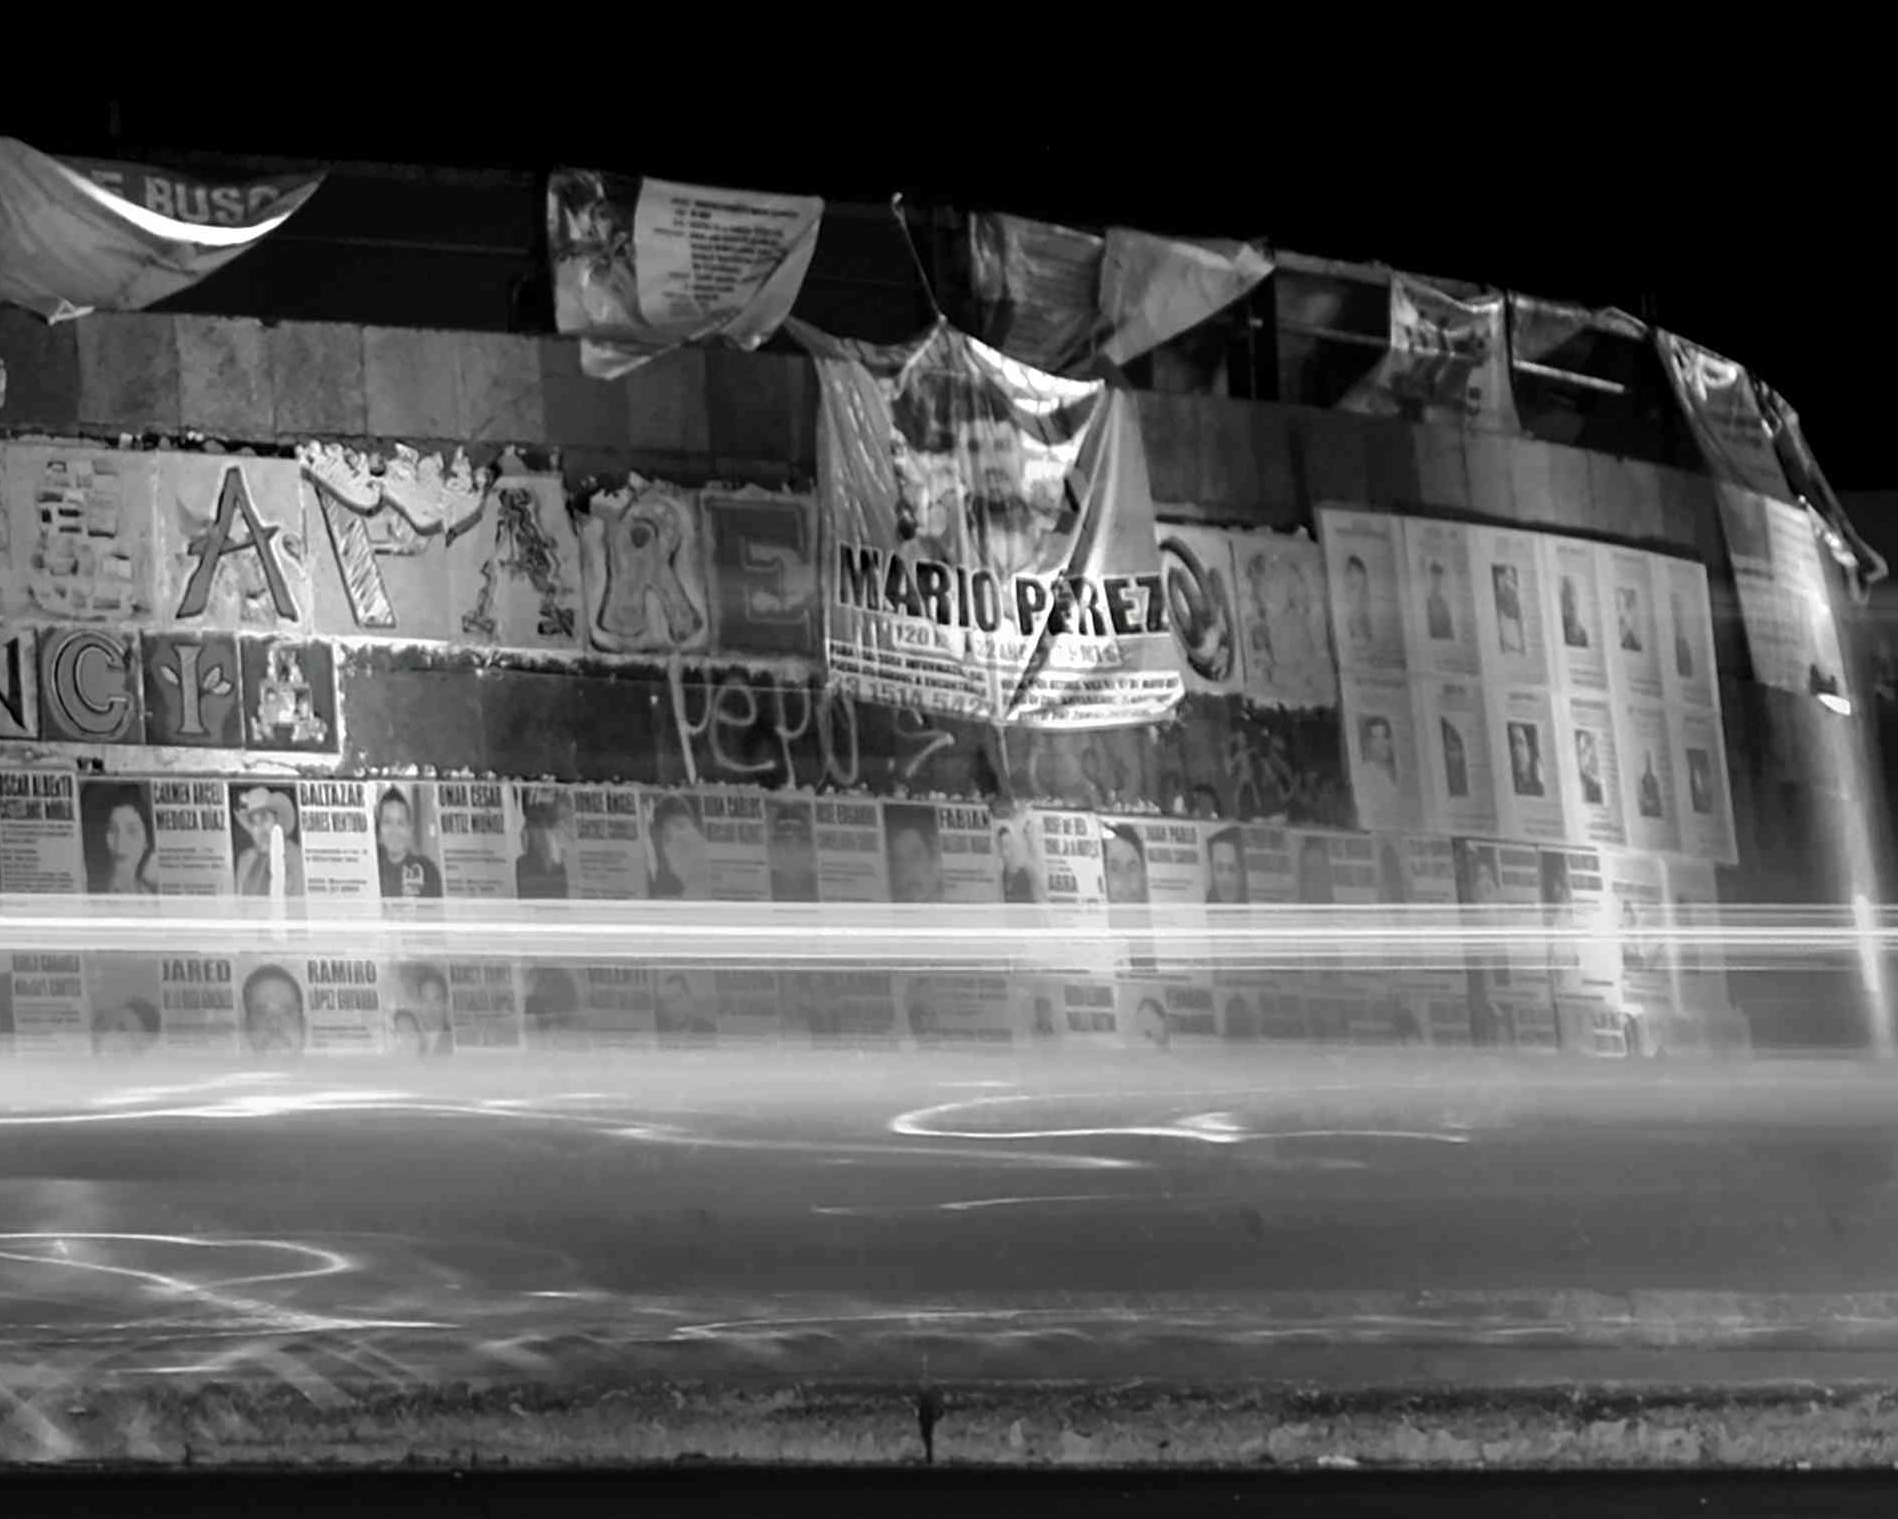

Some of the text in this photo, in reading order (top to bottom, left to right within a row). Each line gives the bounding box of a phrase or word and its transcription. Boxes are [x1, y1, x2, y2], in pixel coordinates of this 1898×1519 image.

[838, 540, 1001, 632] MARIO
[162, 958, 232, 983] JARED
[307, 959, 378, 983] RAMIRO
